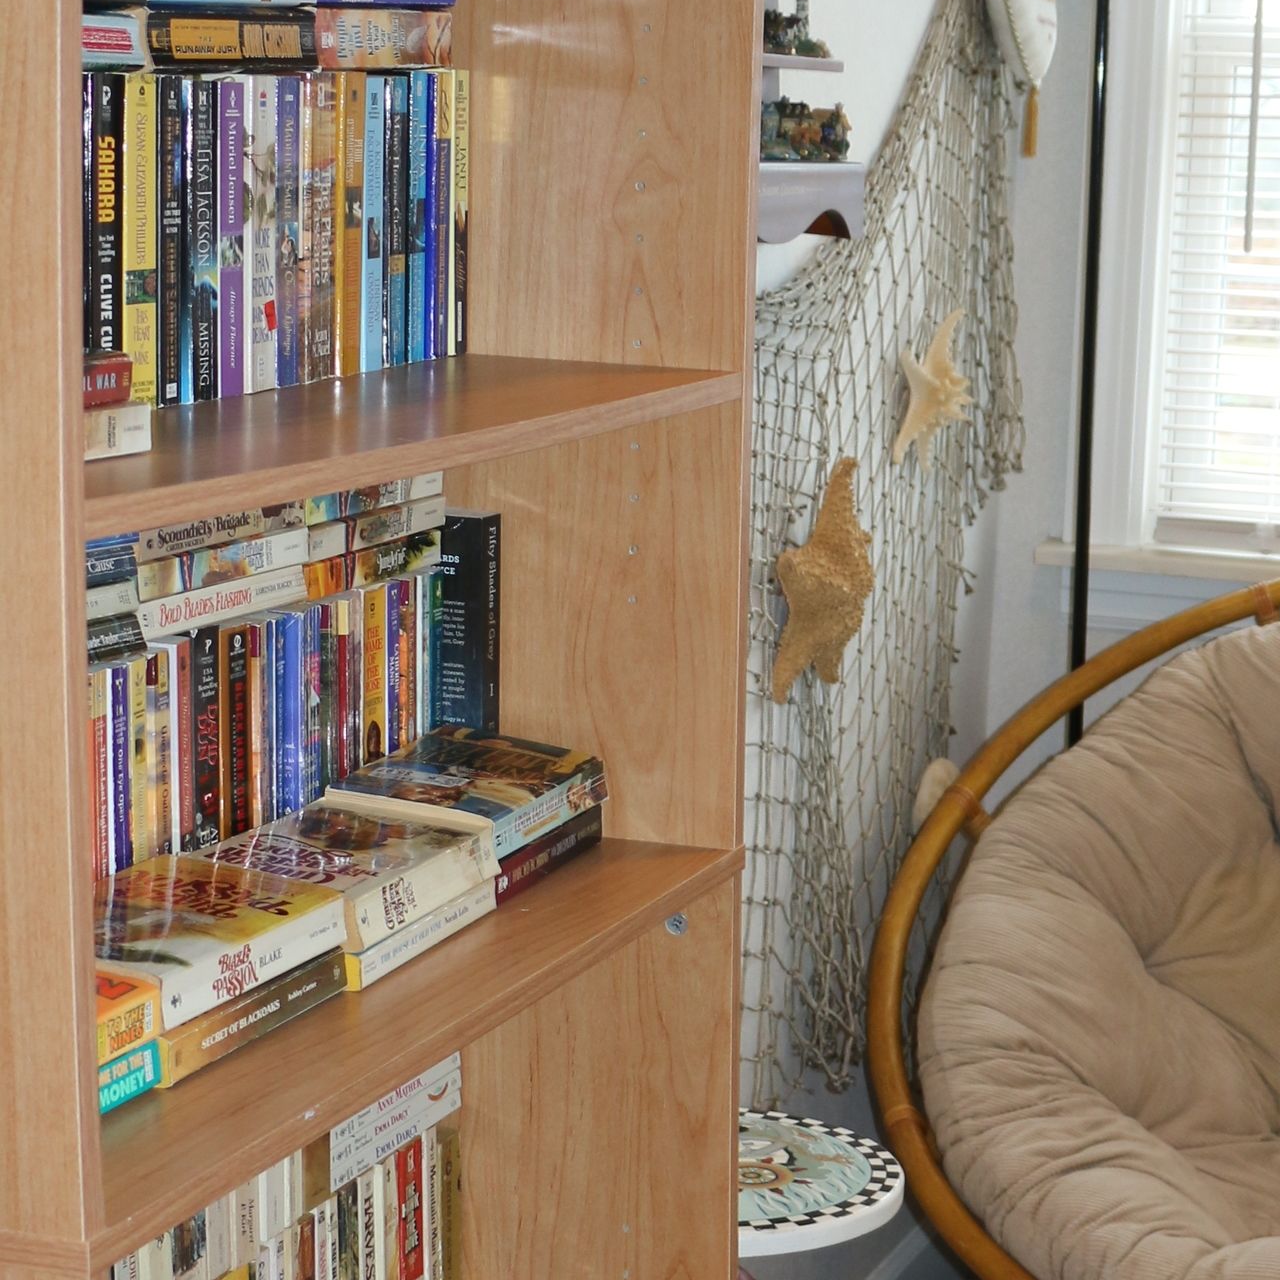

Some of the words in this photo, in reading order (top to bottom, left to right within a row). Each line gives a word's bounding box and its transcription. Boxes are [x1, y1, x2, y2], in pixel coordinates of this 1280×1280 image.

[175, 46, 215, 55] RUNAWAY
[216, 46, 238, 55] JURY
[135, 113, 147, 150] SUSAN
[228, 121, 238, 170] Muriel
[283, 118, 295, 176] MADELINE
[392, 114, 400, 157] MARY
[98, 136, 115, 223] SAHARA
[135, 154, 148, 214] ELIZABETH
[197, 149, 212, 183] LISA
[226, 173, 238, 224] Jensen
[321, 168, 331, 206] The
[135, 217, 149, 265] PHILLIPS
[196, 190, 213, 267] JACKSON
[312, 201, 322, 287] Passage
[321, 217, 331, 284] Plains
[100, 274, 113, 321] CLIVE
[199, 322, 210, 386] MISSING
[229, 326, 237, 369] Florence
[96, 372, 117, 391] WAR
[216, 512, 251, 538] Brigade
[487, 526, 497, 558] Fifty
[87, 558, 115, 574] Cause
[487, 561, 497, 608] Shades
[160, 603, 183, 628] BOLD
[215, 586, 253, 612] FLASHING
[366, 637, 383, 654] NAME
[367, 626, 380, 638] THE
[487, 628, 496, 661] Grey
[366, 677, 382, 692] ROSE
[117, 773, 125, 792] Eye
[258, 947, 283, 968] BLAKE
[212, 961, 259, 1000] PASSION
[110, 1024, 145, 1055] NINES
[201, 1025, 230, 1050] SECRET
[229, 1020, 239, 1038] OF
[239, 999, 281, 1030] BLACKOAKS
[99, 1068, 146, 1107] MONEY
[112, 1060, 129, 1080] FOR
[377, 1096, 394, 1113] ANNE
[390, 1109, 409, 1127] DARCY
[395, 1124, 419, 1146] DARCY
[247, 1199, 255, 1243] Margaret
